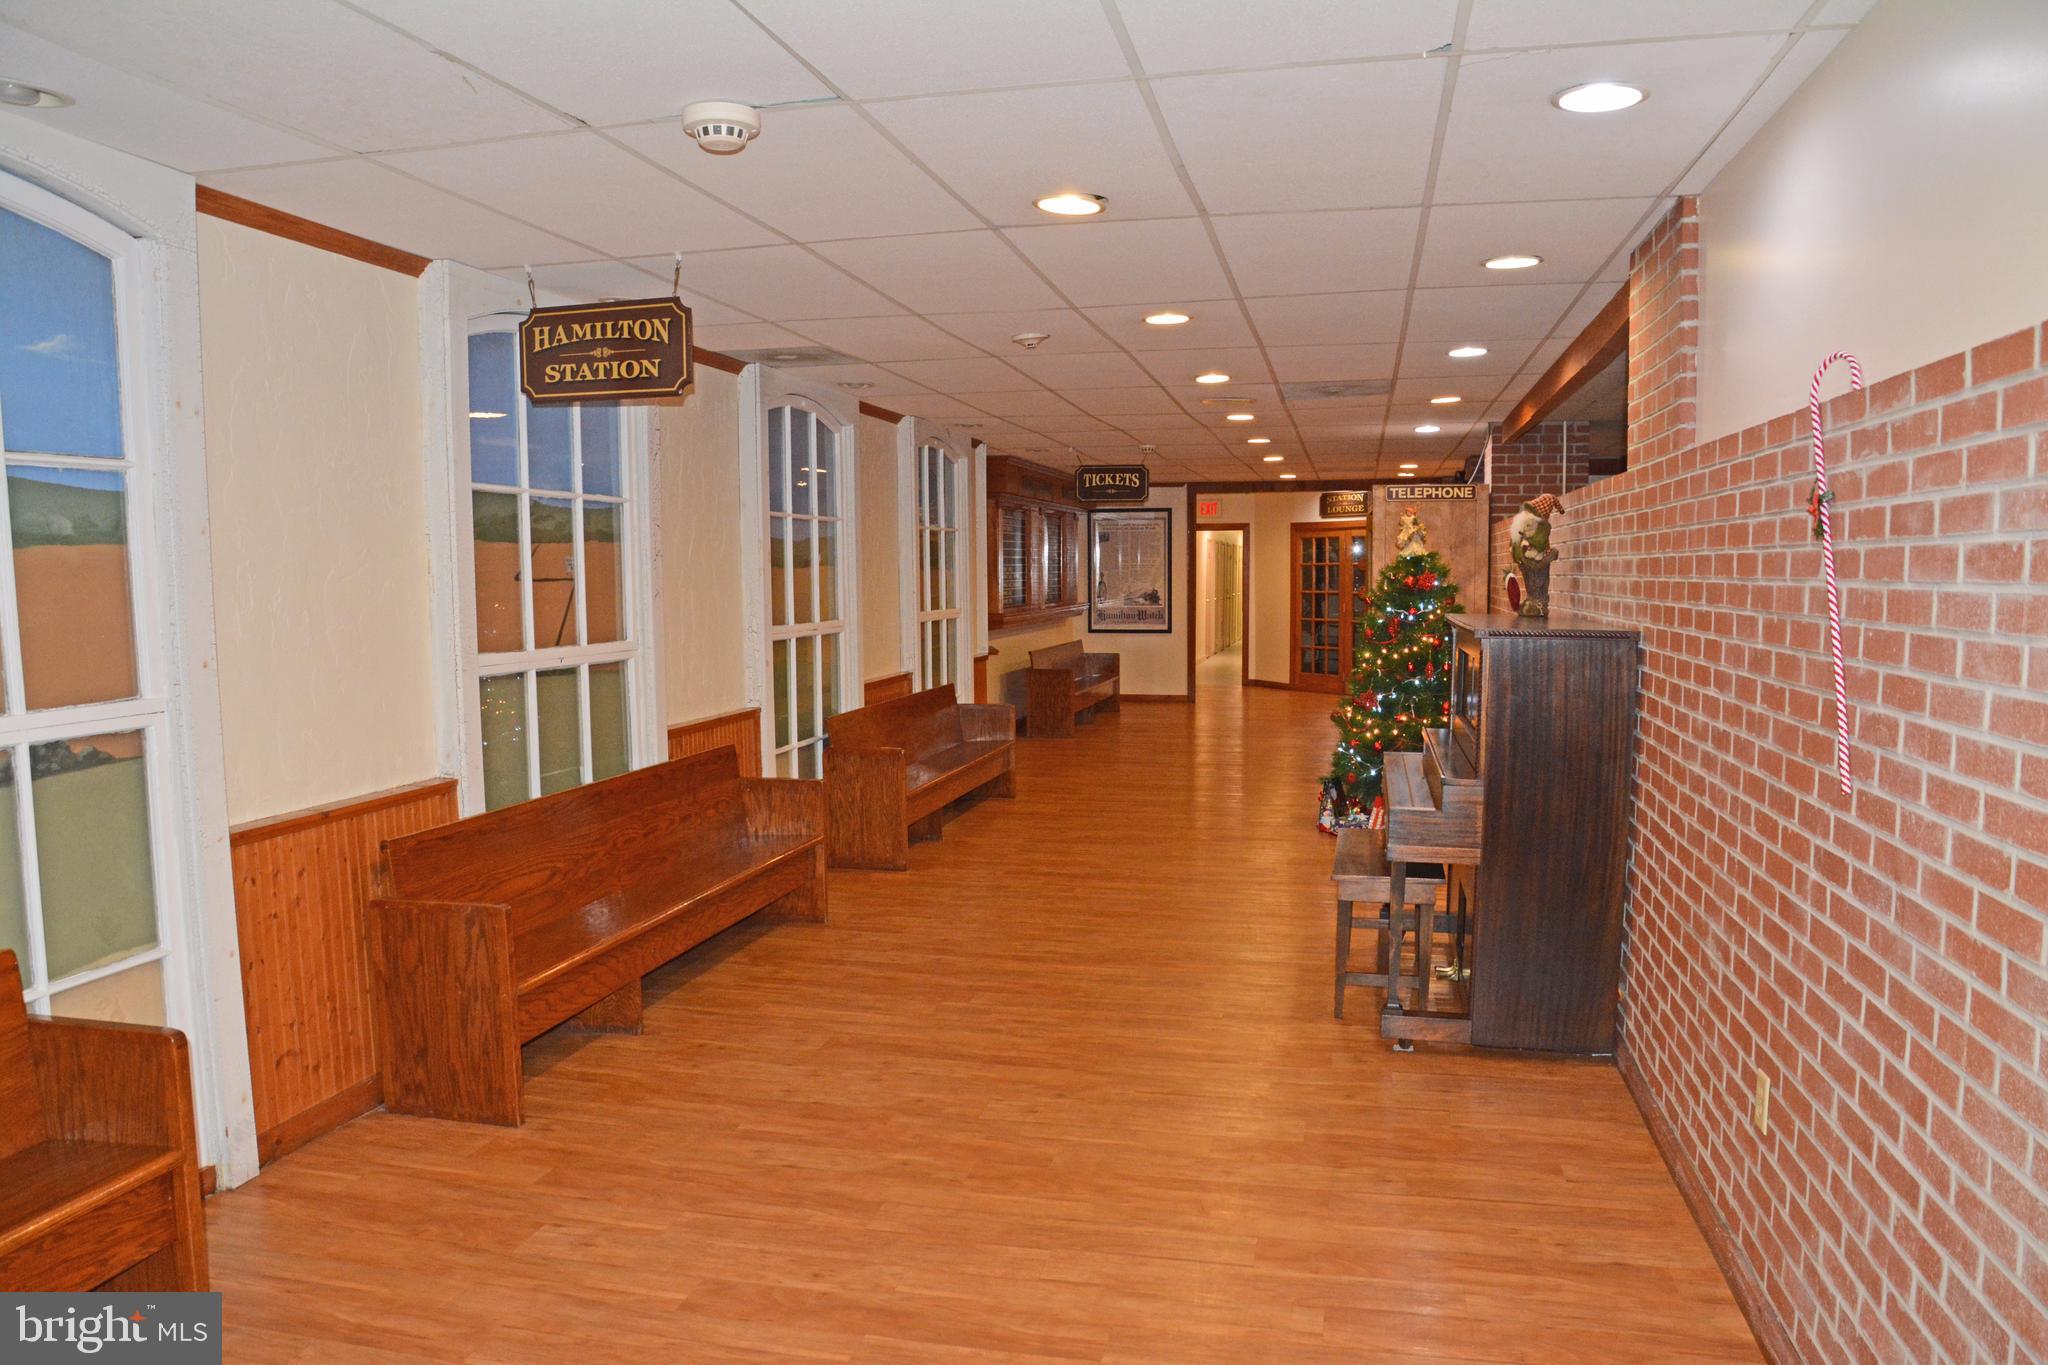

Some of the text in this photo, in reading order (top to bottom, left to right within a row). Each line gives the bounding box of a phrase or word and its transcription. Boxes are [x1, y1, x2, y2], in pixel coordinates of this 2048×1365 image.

[532, 318, 672, 353] HAMILTON
[545, 358, 662, 384] STATION
[1083, 473, 1140, 488] TICKETS
[1327, 493, 1365, 503] STATION
[1389, 487, 1473, 499] TELEPHONE
[1199, 501, 1218, 516] EXIT
[1327, 504, 1365, 513] LOUNGE
